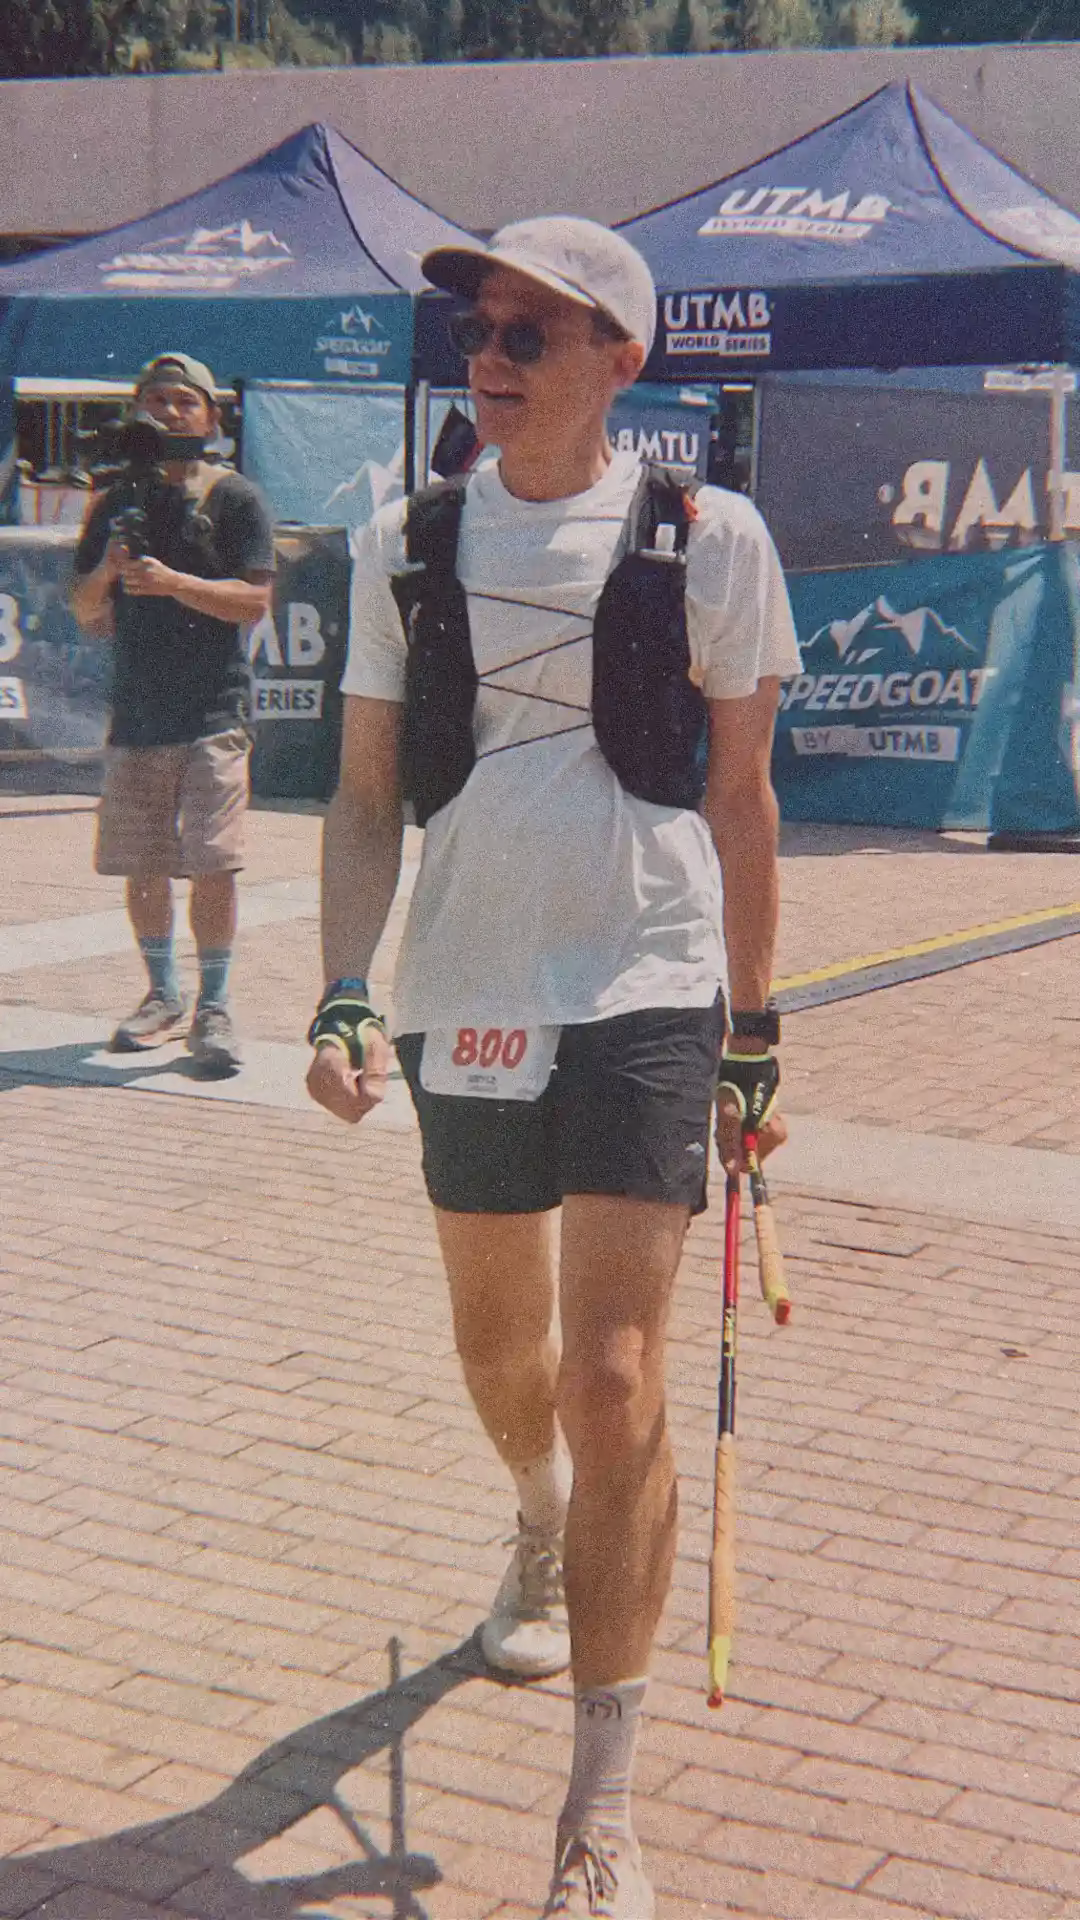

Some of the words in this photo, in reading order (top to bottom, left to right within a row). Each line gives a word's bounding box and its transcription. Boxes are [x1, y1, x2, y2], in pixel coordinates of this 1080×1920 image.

[719, 186, 891, 221] UTMB
[664, 291, 770, 330] UTMB
[671, 335, 720, 348] WORLD
[725, 337, 768, 353] SERIES
[256, 687, 316, 711] ERIES
[803, 731, 830, 749] BY
[867, 731, 942, 753] UTMB
[451, 1027, 528, 1069] 800
